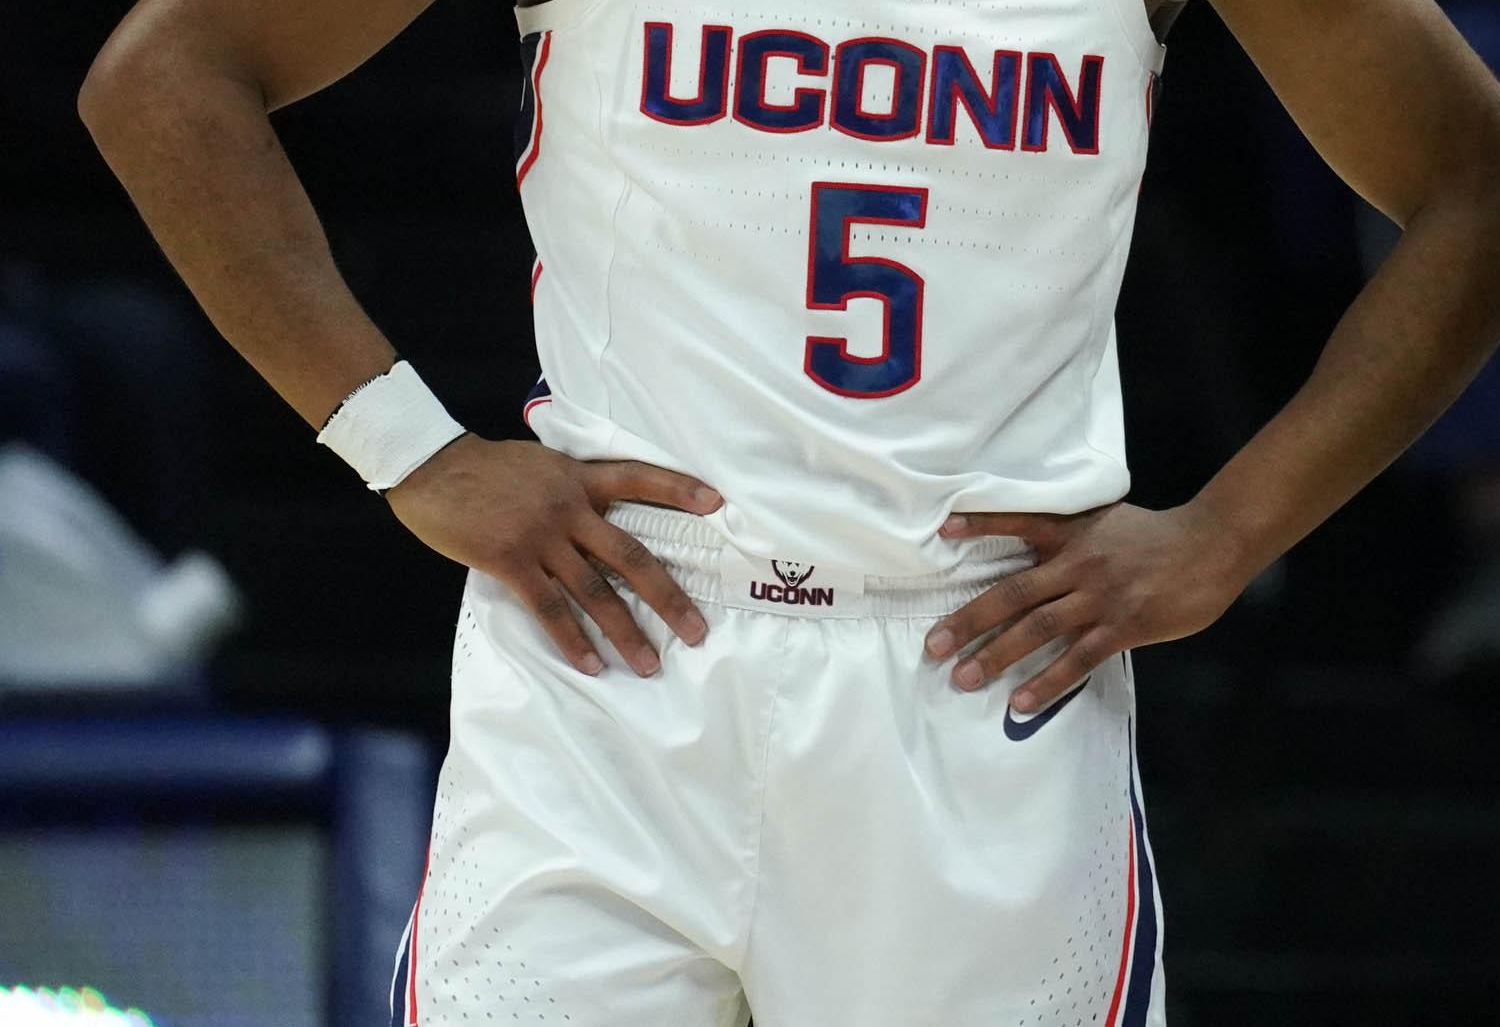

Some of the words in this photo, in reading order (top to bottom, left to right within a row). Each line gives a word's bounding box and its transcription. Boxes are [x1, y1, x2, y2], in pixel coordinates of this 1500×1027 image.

[640, 22, 1104, 155] UCONN
[804, 181, 928, 398] 5
[750, 581, 834, 606] UCONN
